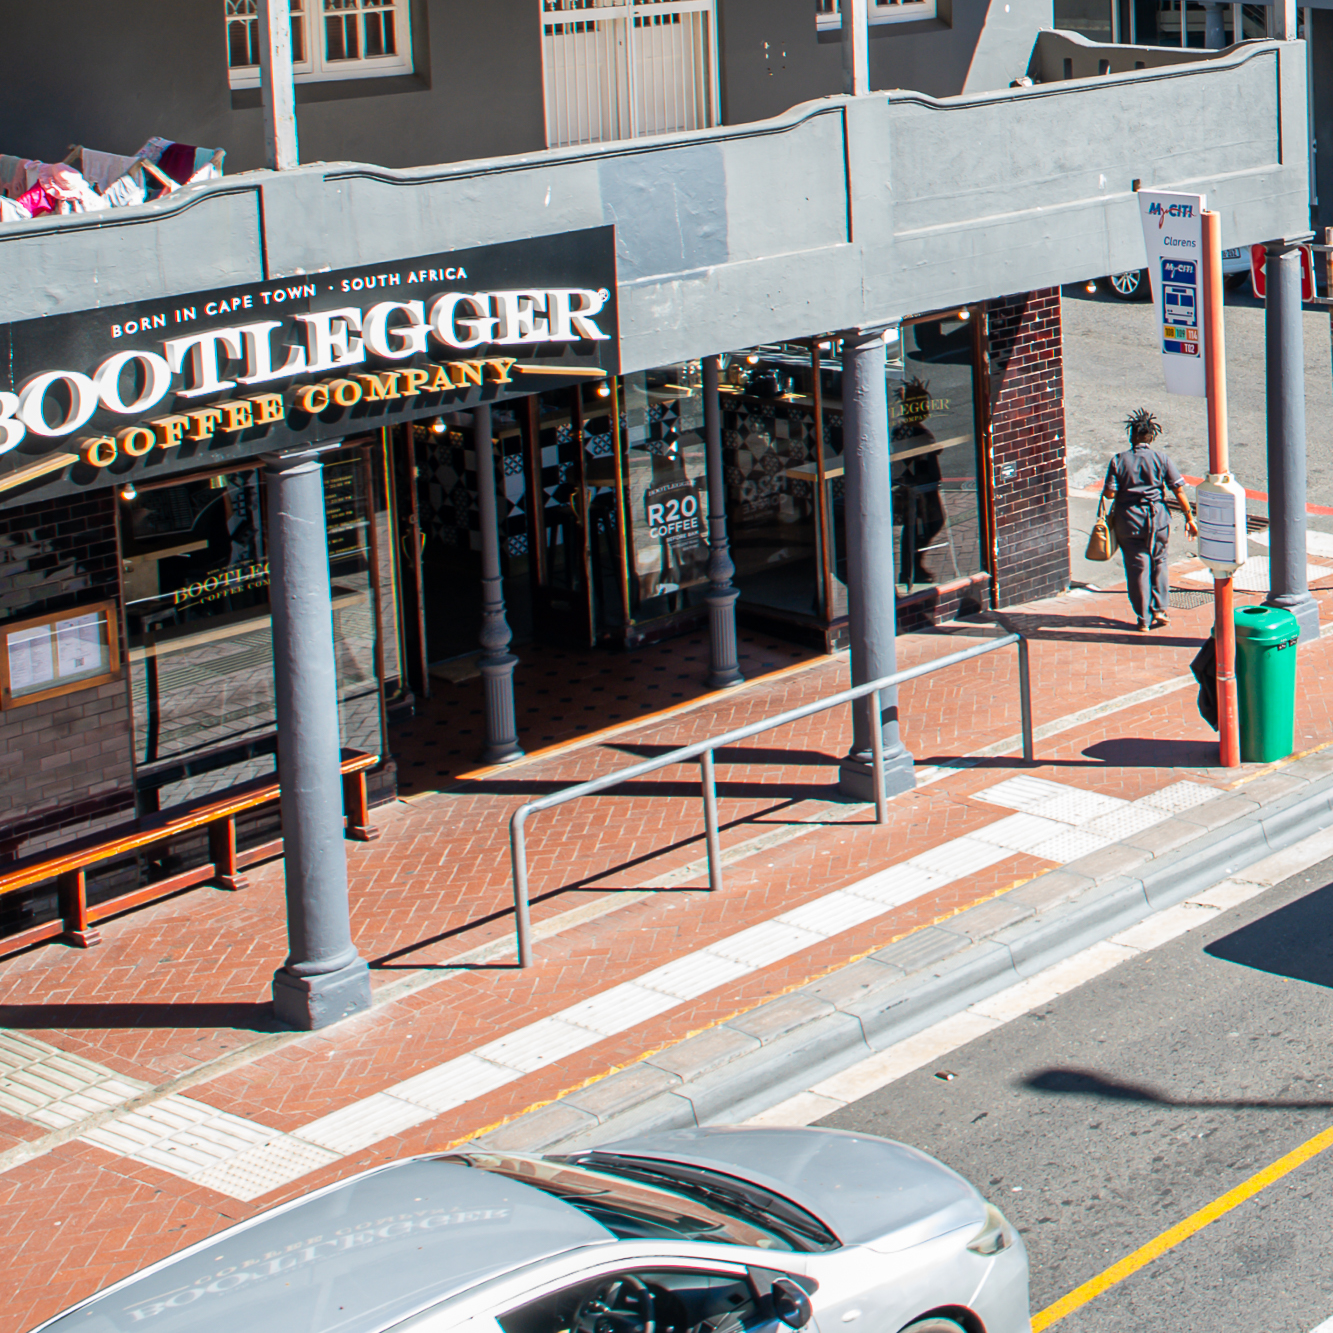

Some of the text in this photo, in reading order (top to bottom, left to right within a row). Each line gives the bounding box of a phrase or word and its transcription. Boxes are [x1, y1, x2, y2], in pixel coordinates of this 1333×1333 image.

[1164, 236, 1197, 247] Clarens
[111, 266, 467, 338] BORN IN CAPE TOWN SOUTH AFRICA
[1165, 327, 1174, 337] 108
[1188, 330, 1198, 340] 114
[1184, 343, 1195, 353] T02
[85, 358, 518, 467] COFFEE COMPANY
[648, 495, 698, 526] R20
[649, 517, 699, 539] COFFEE
